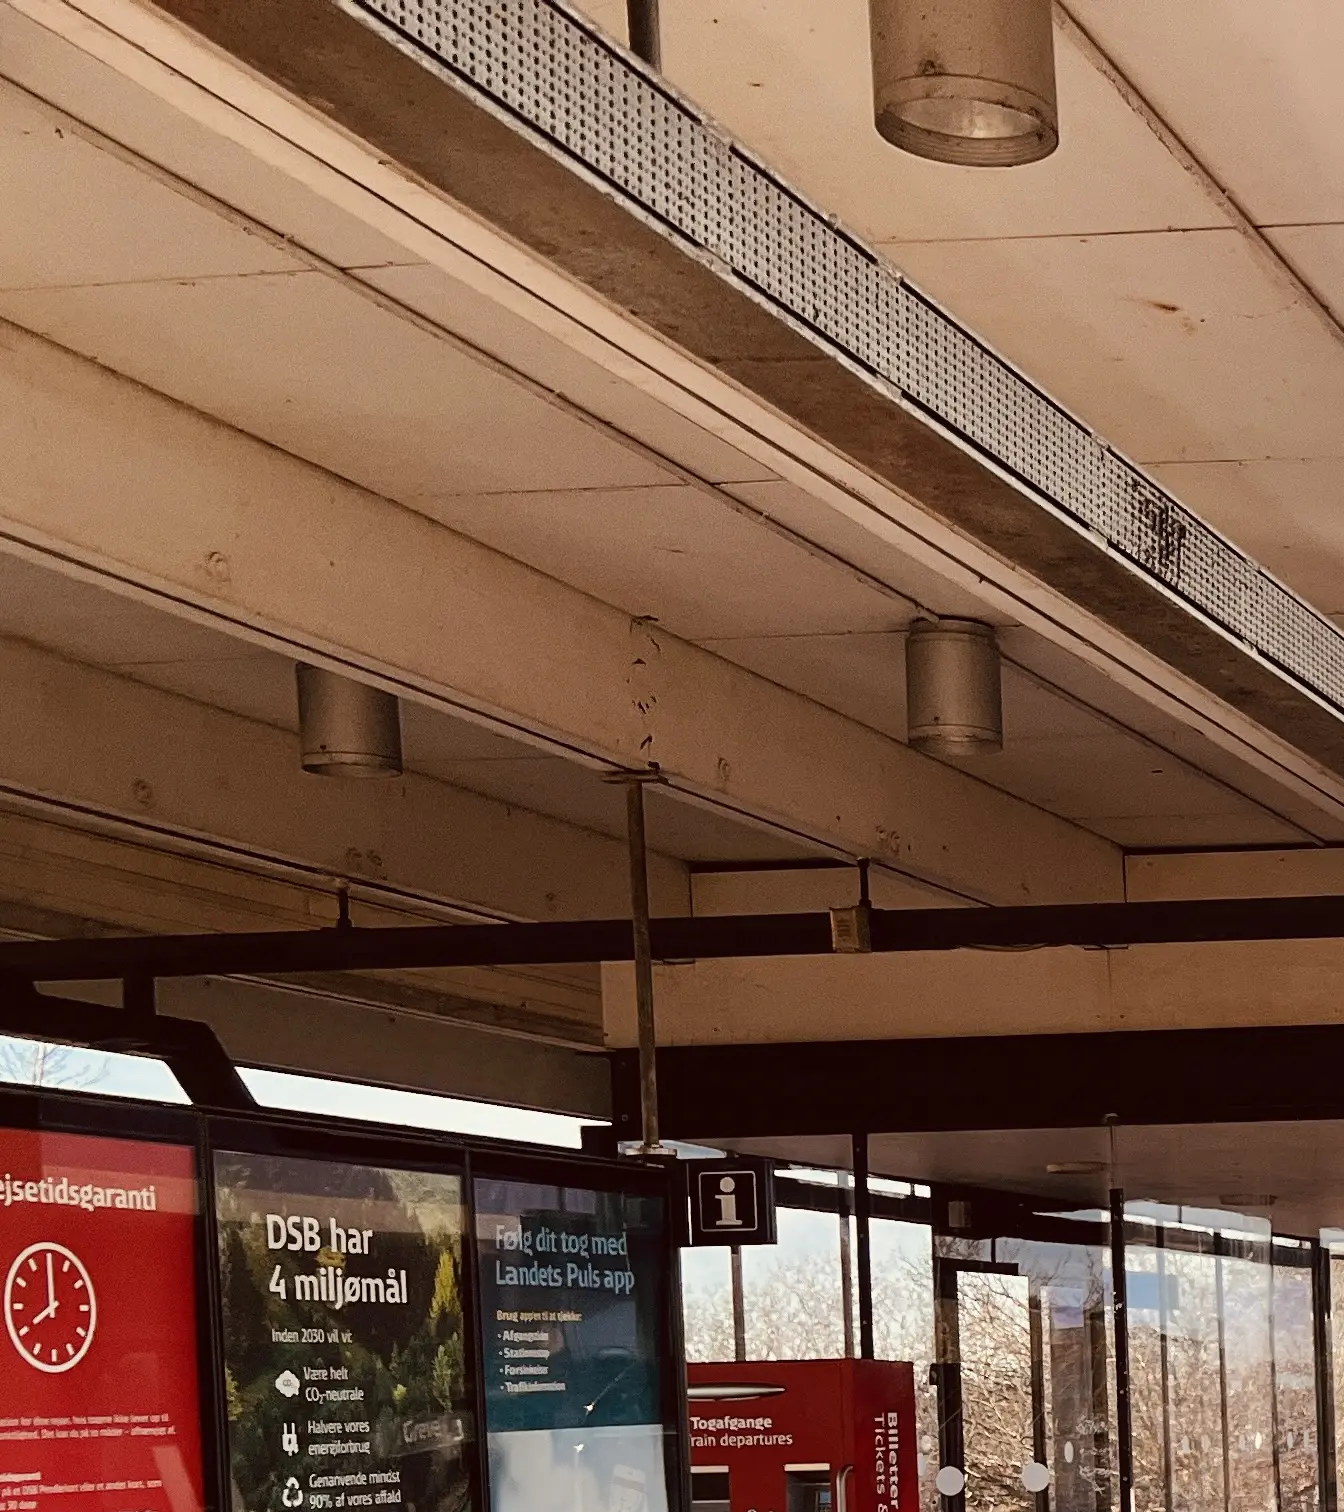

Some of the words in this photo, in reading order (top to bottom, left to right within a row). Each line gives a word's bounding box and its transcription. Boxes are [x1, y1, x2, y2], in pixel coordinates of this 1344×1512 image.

[266, 1214, 321, 1252] DSB
[329, 1217, 373, 1254] har
[496, 1225, 532, 1256] Følg
[535, 1227, 558, 1253] dit
[561, 1232, 590, 1259] tog
[592, 1232, 628, 1256] med
[496, 1260, 562, 1287] Landets
[567, 1263, 601, 1288] Puls
[604, 1270, 635, 1295] app
[269, 1265, 287, 1300] 4
[294, 1267, 408, 1310] miljømål
[496, 1309, 519, 1323] Brug
[271, 1328, 299, 1343] Inden
[301, 1328, 325, 1343] 2030
[327, 1329, 339, 1344] vil
[303, 1367, 327, 1381] Være
[329, 1366, 349, 1380] helt
[307, 1420, 343, 1434] Halvere
[345, 1420, 370, 1433] vores
[690, 1415, 772, 1431] Togafgange
[690, 1433, 716, 1447] rain
[720, 1432, 793, 1449] departures
[874, 1413, 886, 1494] Tickets
[887, 1412, 900, 1509] Billetter
[309, 1473, 367, 1488] Genanvende
[368, 1470, 401, 1484] mindst
[309, 1494, 333, 1510] 90%
[335, 1493, 345, 1507] af
[347, 1494, 373, 1506] vores
[374, 1489, 401, 1503] affald
